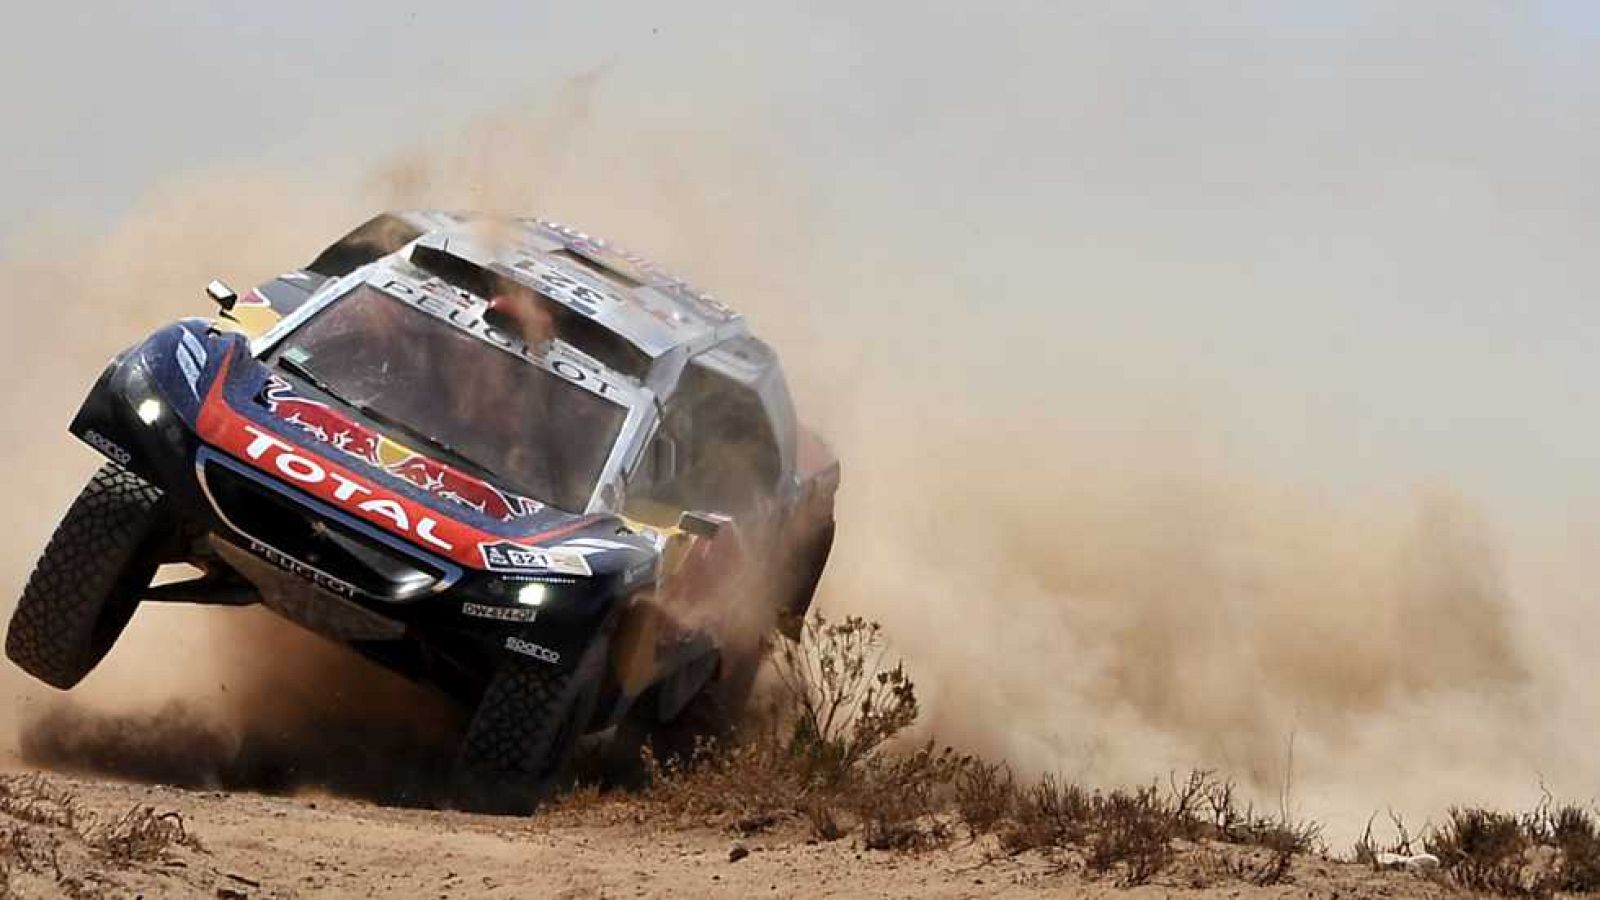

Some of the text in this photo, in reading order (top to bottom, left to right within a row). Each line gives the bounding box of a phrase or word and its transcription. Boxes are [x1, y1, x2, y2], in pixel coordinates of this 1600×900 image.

[84, 430, 131, 465] sparco
[244, 424, 454, 551] TOTAL
[250, 541, 358, 599] PEUGEOT
[511, 551, 549, 566] 321
[505, 636, 561, 664] sparco
